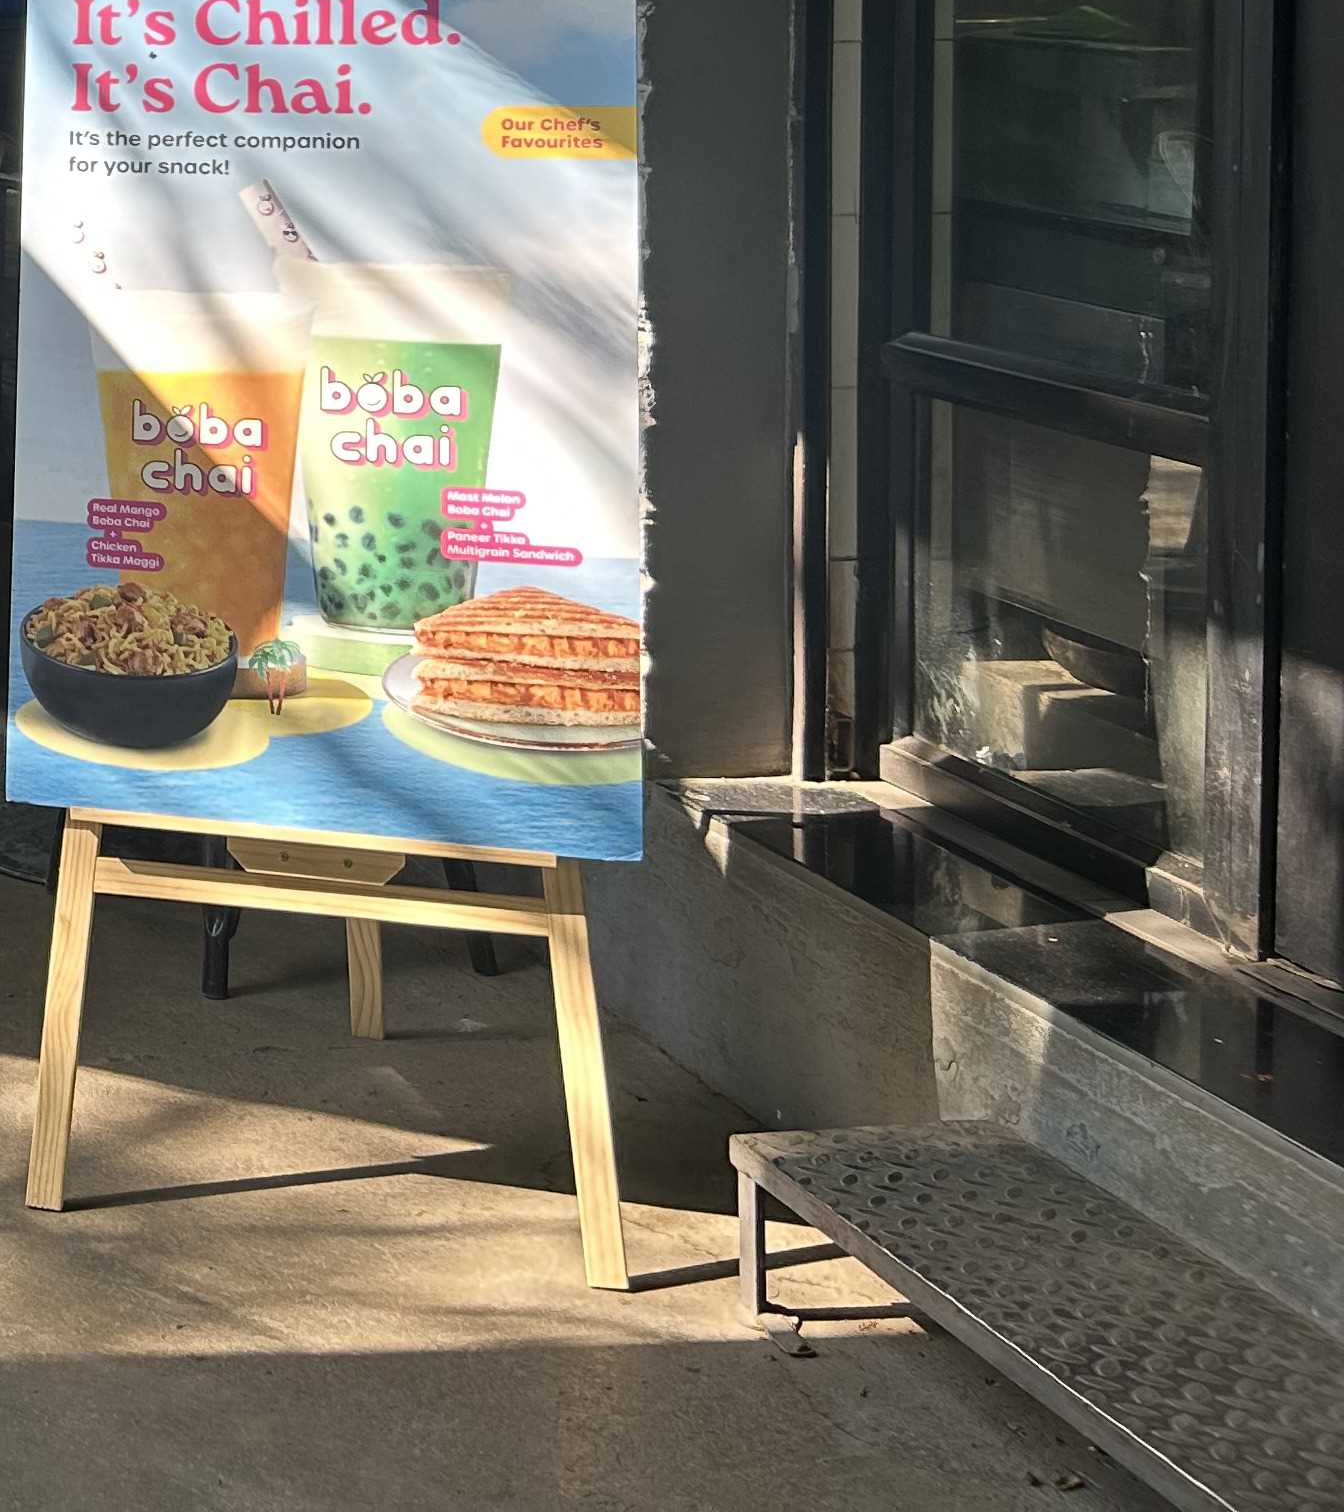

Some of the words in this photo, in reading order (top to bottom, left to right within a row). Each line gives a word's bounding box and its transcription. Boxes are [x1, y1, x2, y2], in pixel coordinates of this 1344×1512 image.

[70, 62, 176, 114] It's
[193, 62, 373, 115] Chai.
[501, 118, 535, 131] Our
[540, 116, 601, 132] Chef's
[69, 130, 100, 147] It's
[106, 130, 141, 147] the
[148, 130, 228, 151] perfect
[233, 132, 360, 153] companion
[501, 134, 603, 149] Favourites
[69, 156, 98, 173] for
[103, 158, 153, 177] your
[157, 158, 229, 176] snack!
[329, 417, 456, 470] chai
[140, 447, 255, 498] chai
[481, 493, 521, 505] Melon
[92, 503, 117, 513] Real
[119, 504, 160, 517] Mango
[447, 503, 480, 516] Boba
[481, 506, 511, 517] Chai
[92, 515, 122, 526] Boba
[124, 517, 150, 528] Chai
[447, 531, 491, 542] Paneer
[493, 533, 526, 545] Tikka
[91, 540, 137, 553] Chicken
[447, 544, 510, 558] Multigrain
[512, 548, 575, 562] Sandwich
[91, 553, 121, 564] Tikka
[122, 555, 160, 569] Maggi
